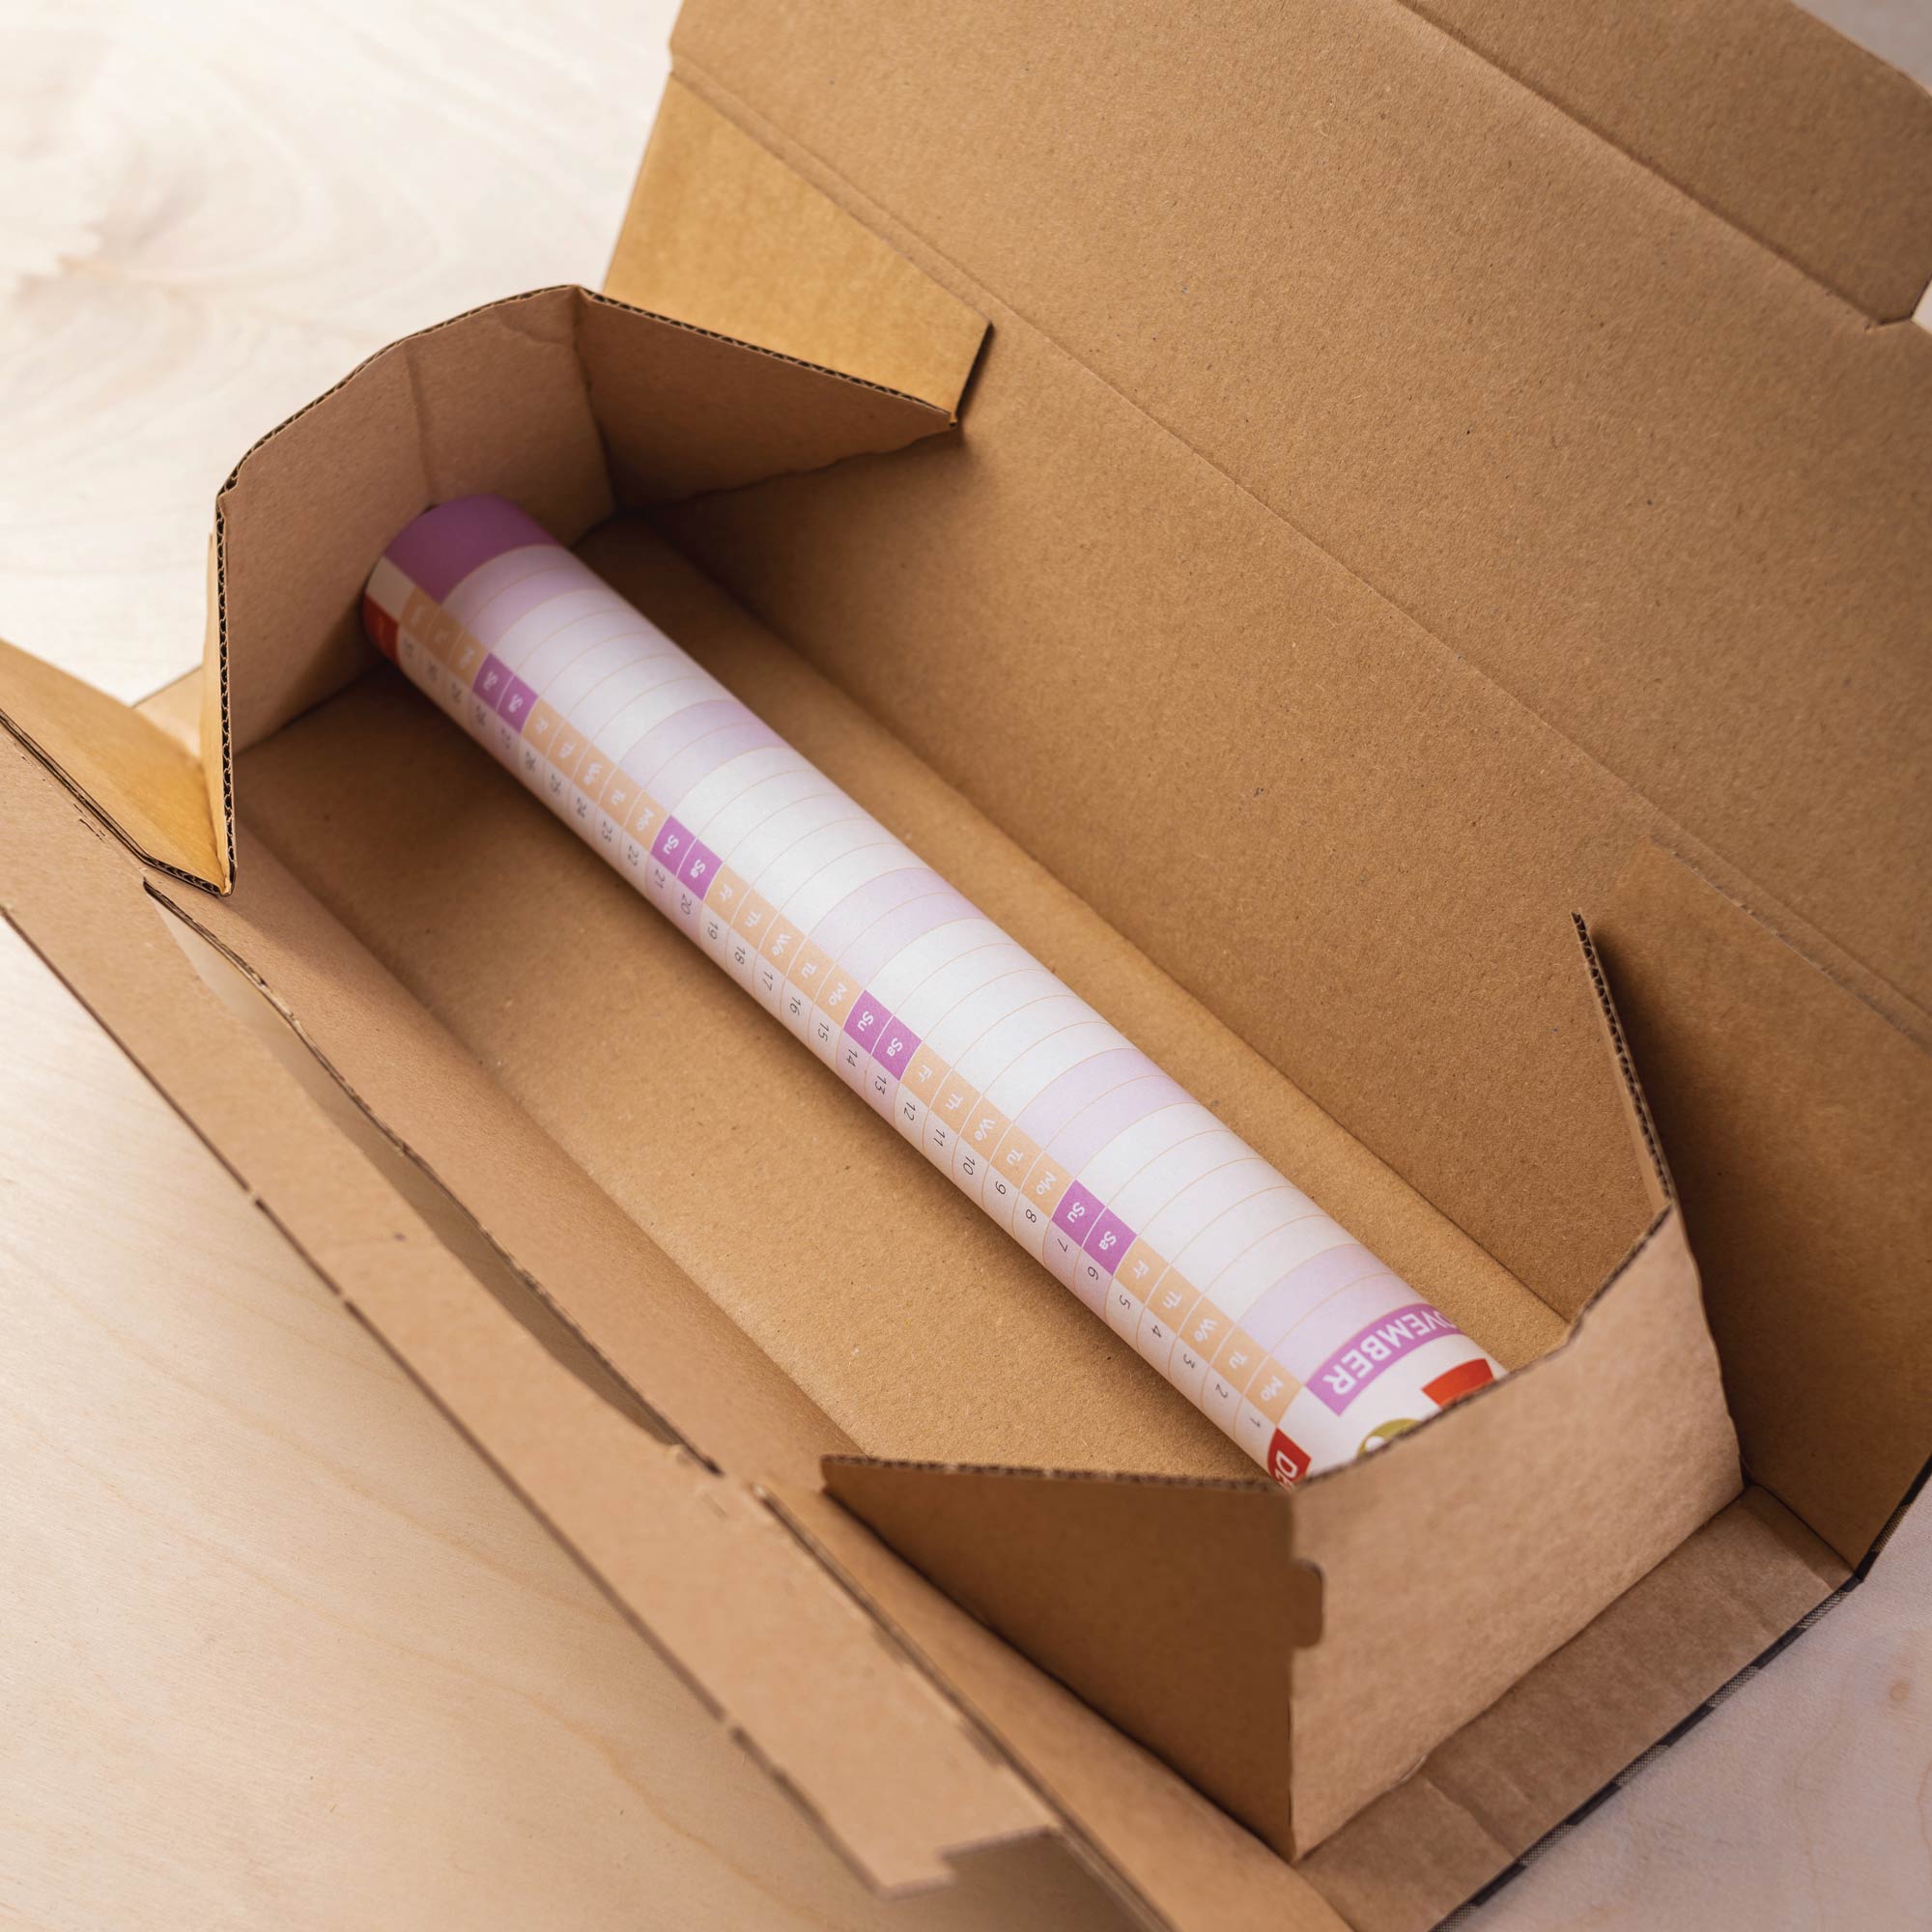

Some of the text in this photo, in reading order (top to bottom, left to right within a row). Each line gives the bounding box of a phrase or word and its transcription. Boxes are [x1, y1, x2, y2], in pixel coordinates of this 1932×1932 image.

[628, 843, 639, 867] 22
[655, 834, 678, 889] Su 21
[680, 859, 706, 915] Sa 20
[708, 884, 733, 940] Fr 19
[734, 911, 761, 965] Th 18
[763, 932, 791, 991] We 17
[790, 961, 817, 1015] Tu 16
[818, 982, 847, 1041] Mo 15
[846, 1010, 873, 1067] Su 14
[874, 1037, 902, 1095] Sa 13
[904, 1065, 932, 1122] Fr 12
[933, 1094, 963, 1148] Th 11
[963, 1119, 995, 1175] We 10
[995, 1150, 1023, 1195] Tu 9
[1026, 1171, 1057, 1223] Mo 8
[1057, 1202, 1085, 1252] Su 7
[1088, 1231, 1117, 1280] Sa 6
[1119, 1259, 1149, 1309] Fr 5
[1151, 1290, 1182, 1338] Th 4
[1183, 1318, 1218, 1369] We 3
[1215, 1350, 1248, 1399] Tu 2
[1249, 1376, 1284, 1430] Mo 1
